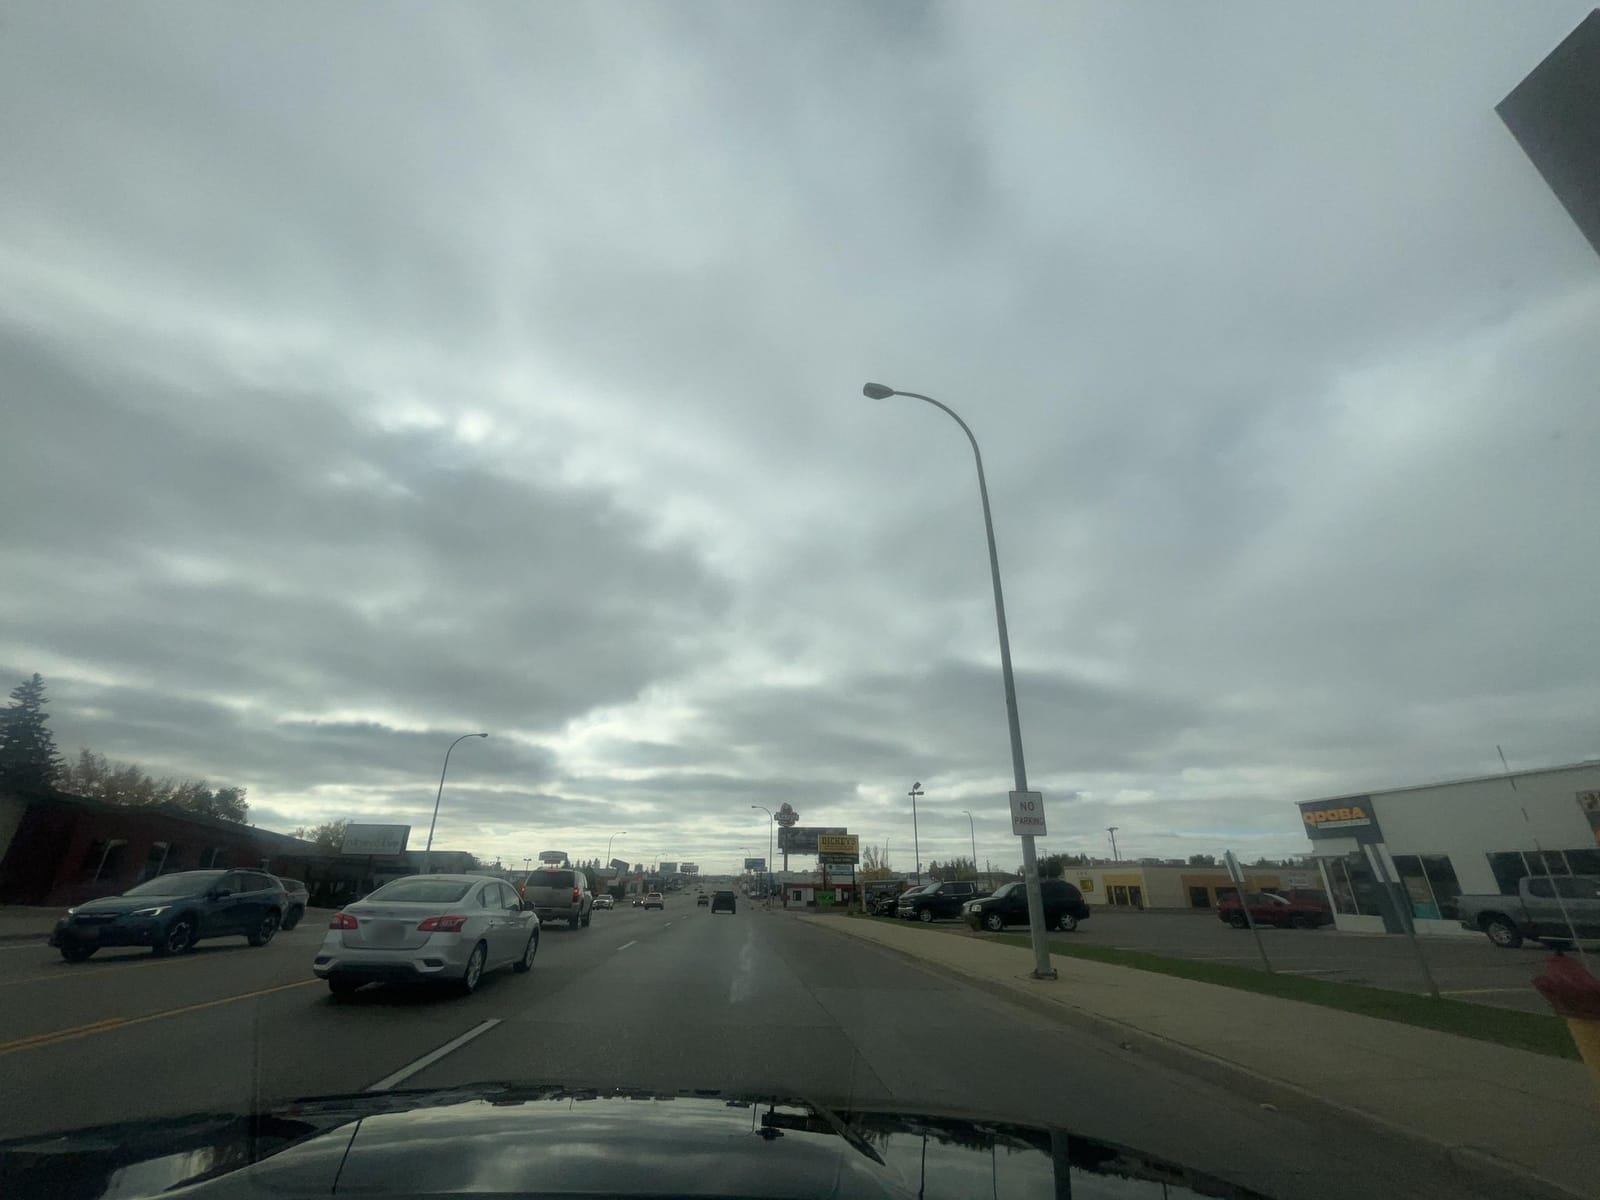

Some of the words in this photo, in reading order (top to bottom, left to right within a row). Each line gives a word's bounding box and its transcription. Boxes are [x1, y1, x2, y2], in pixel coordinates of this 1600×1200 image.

[1020, 801, 1035, 812] NO
[1014, 816, 1045, 826] PARKING
[1304, 806, 1366, 826] QDOBA
